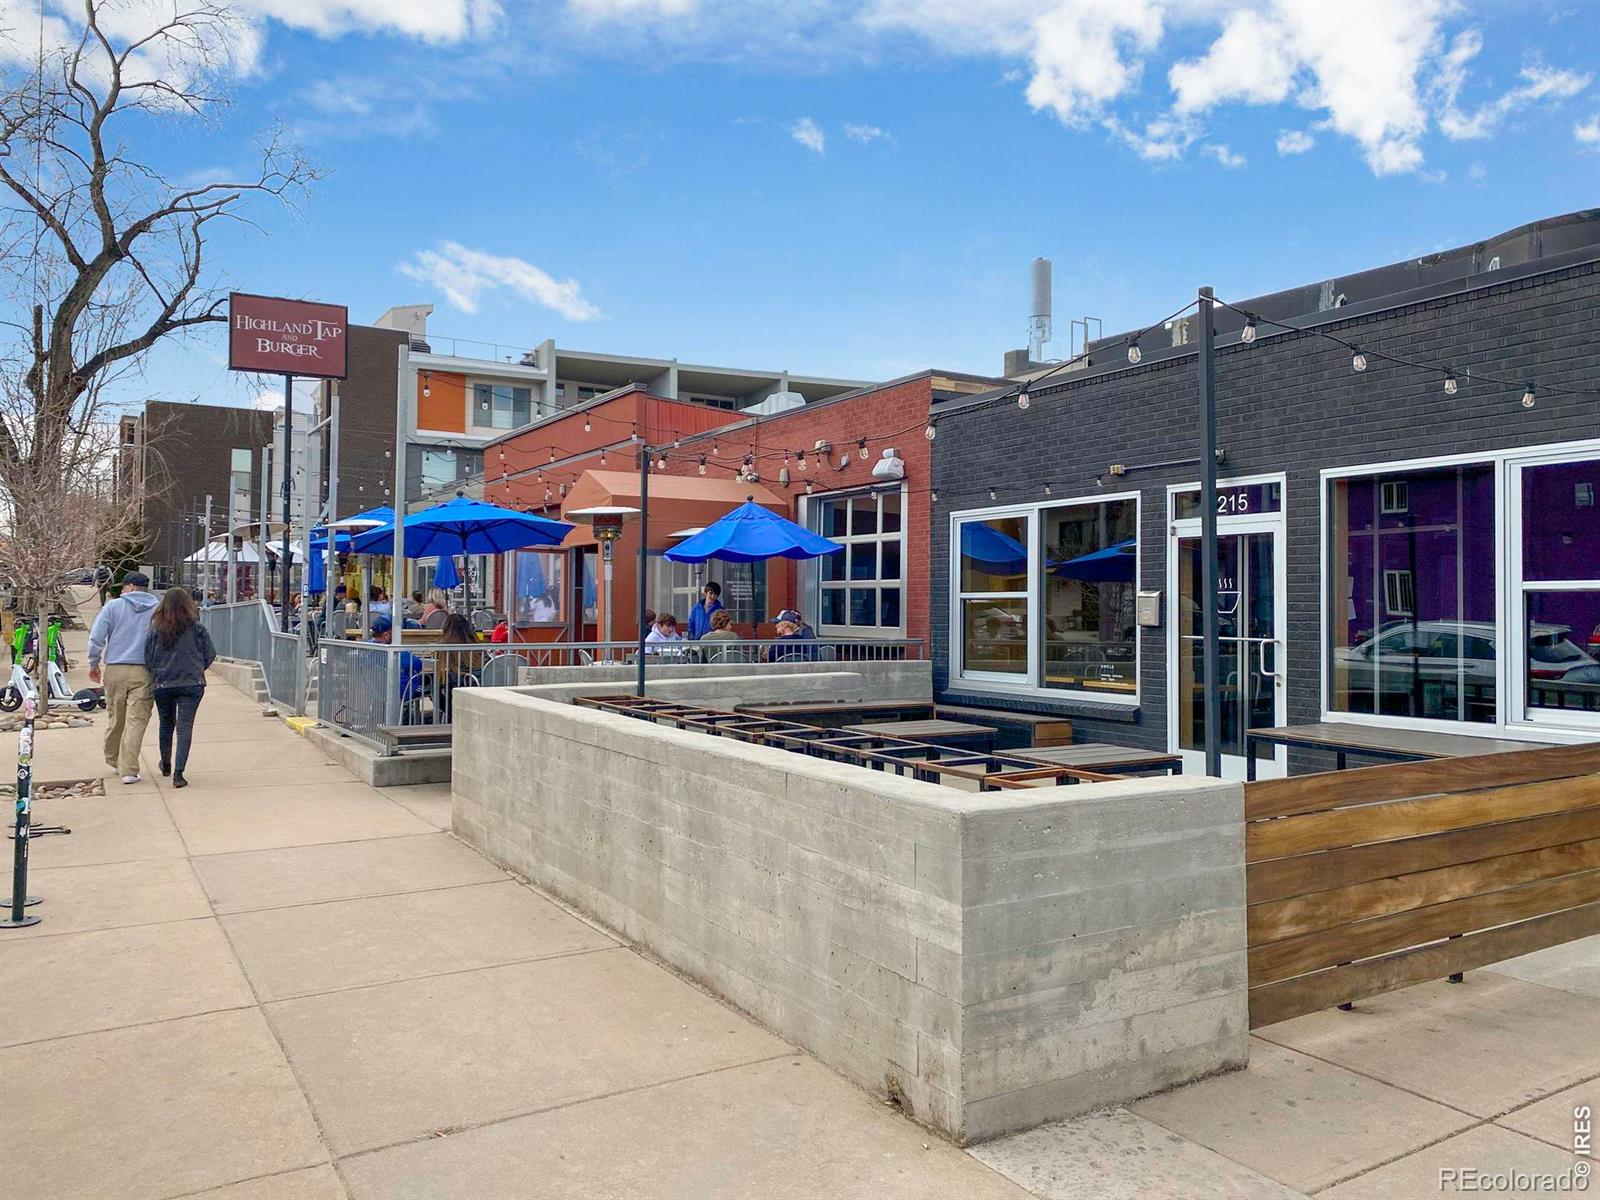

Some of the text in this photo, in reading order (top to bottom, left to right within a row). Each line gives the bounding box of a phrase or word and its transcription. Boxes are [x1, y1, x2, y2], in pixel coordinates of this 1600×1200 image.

[236, 314, 342, 341] HIGHLAND TAP
[281, 334, 298, 342] AND
[256, 338, 323, 359] BURGER
